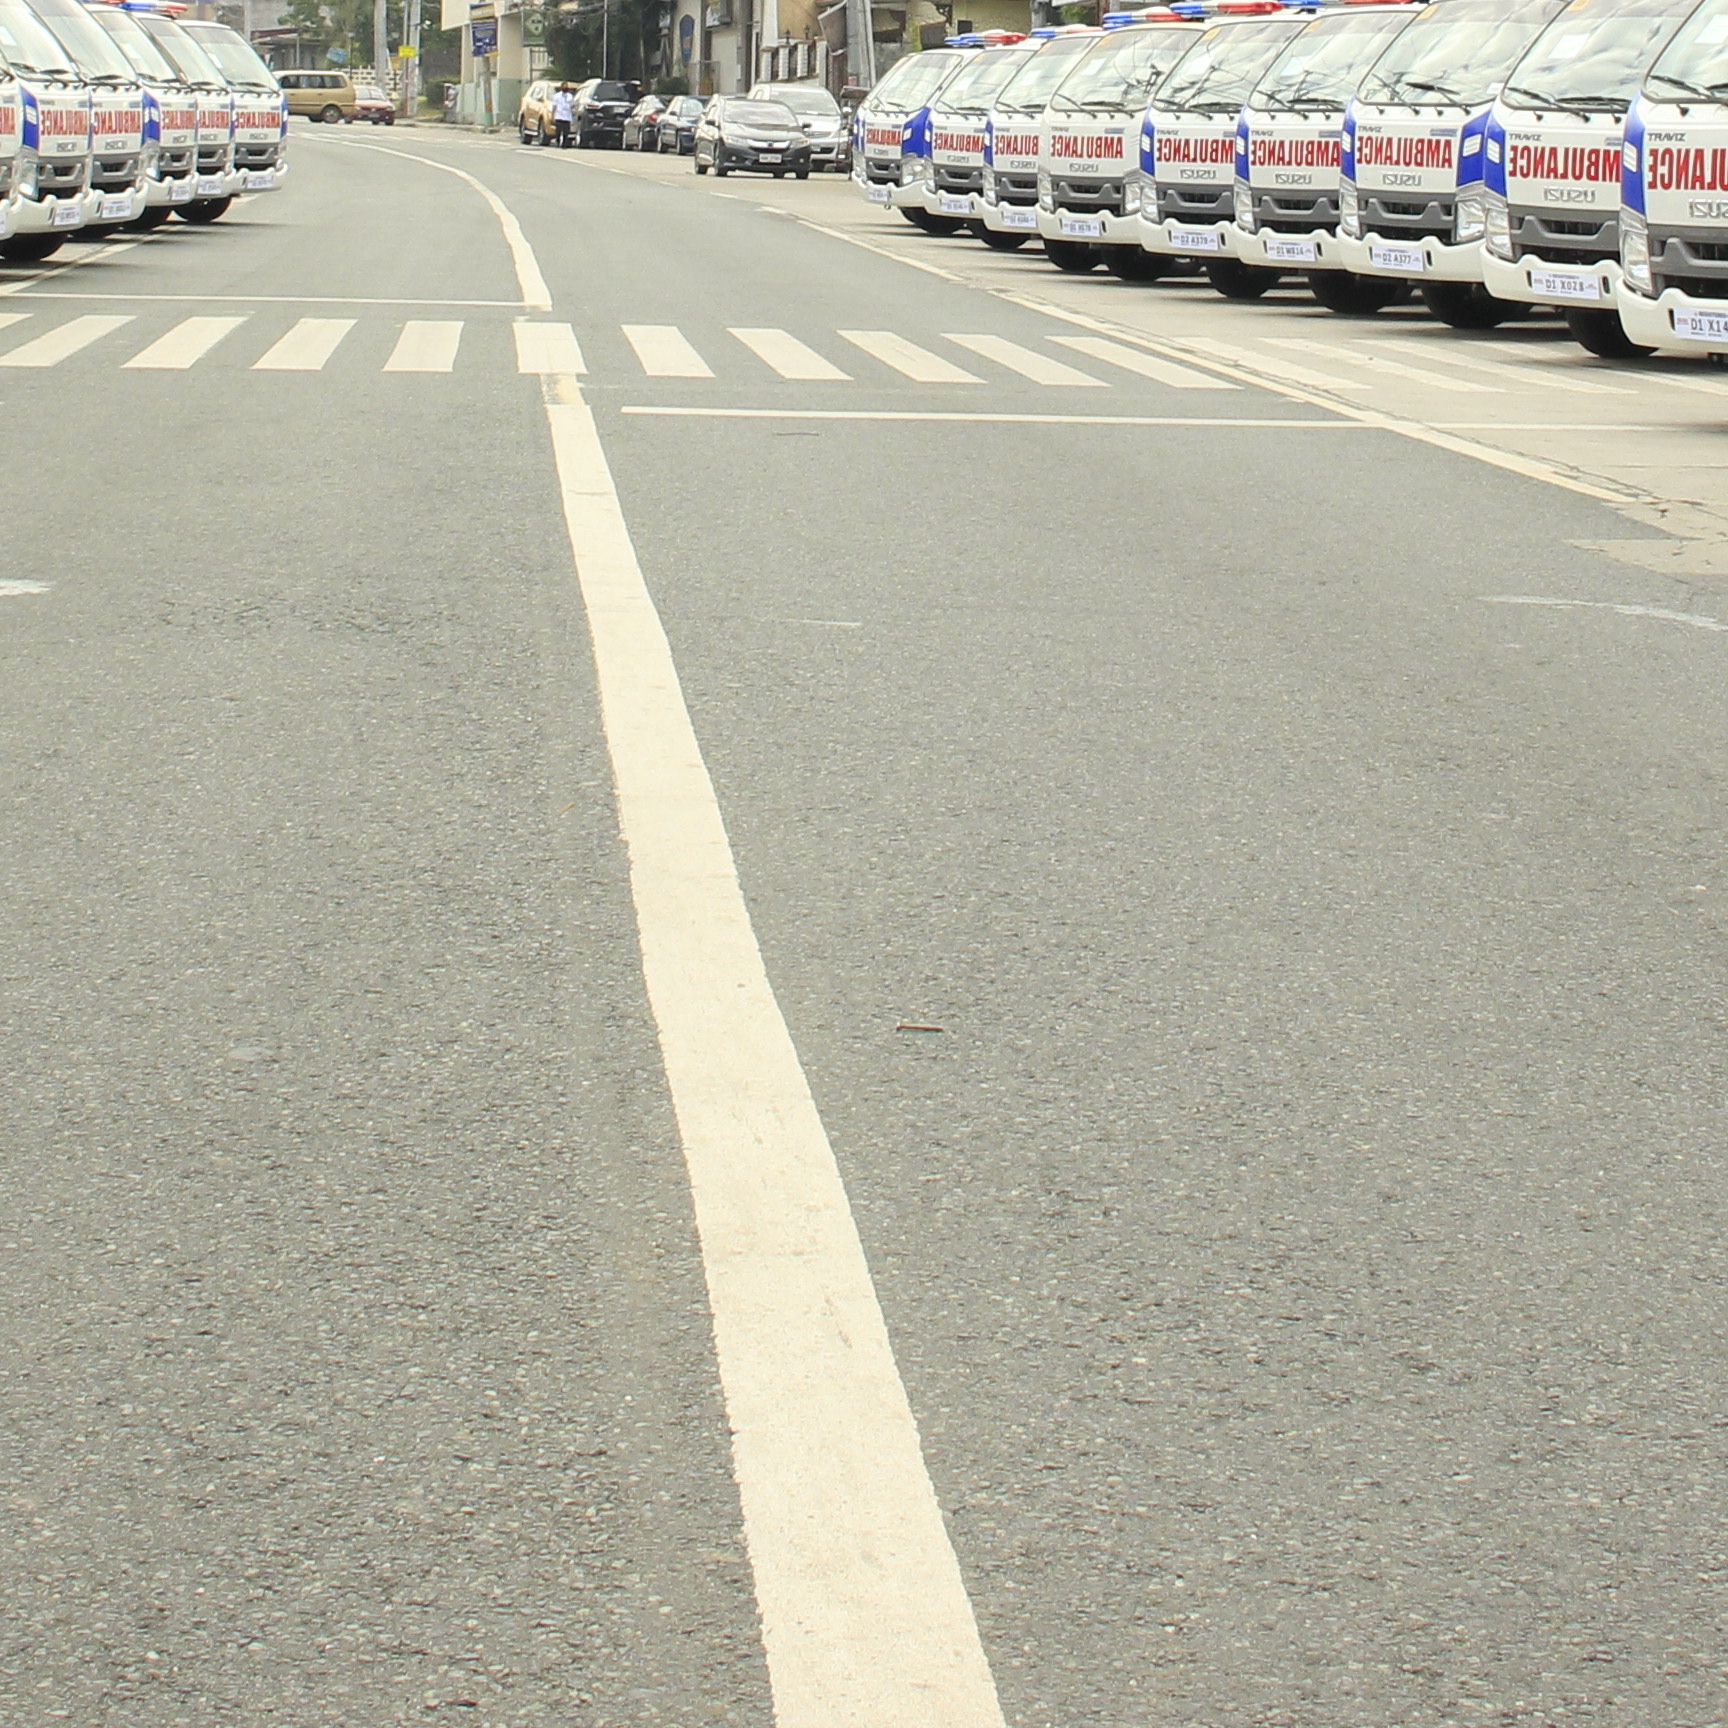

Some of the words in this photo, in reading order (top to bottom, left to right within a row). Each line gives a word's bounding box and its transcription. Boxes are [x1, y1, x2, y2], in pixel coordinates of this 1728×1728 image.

[1509, 133, 1541, 141] TRAVIZ
[1648, 132, 1685, 142] TRAVIZ
[1181, 169, 1216, 179] ISUZU
[1275, 173, 1312, 184] ISUZU
[1383, 173, 1421, 186] ISUZU
[1543, 186, 1596, 203] ISUZU
